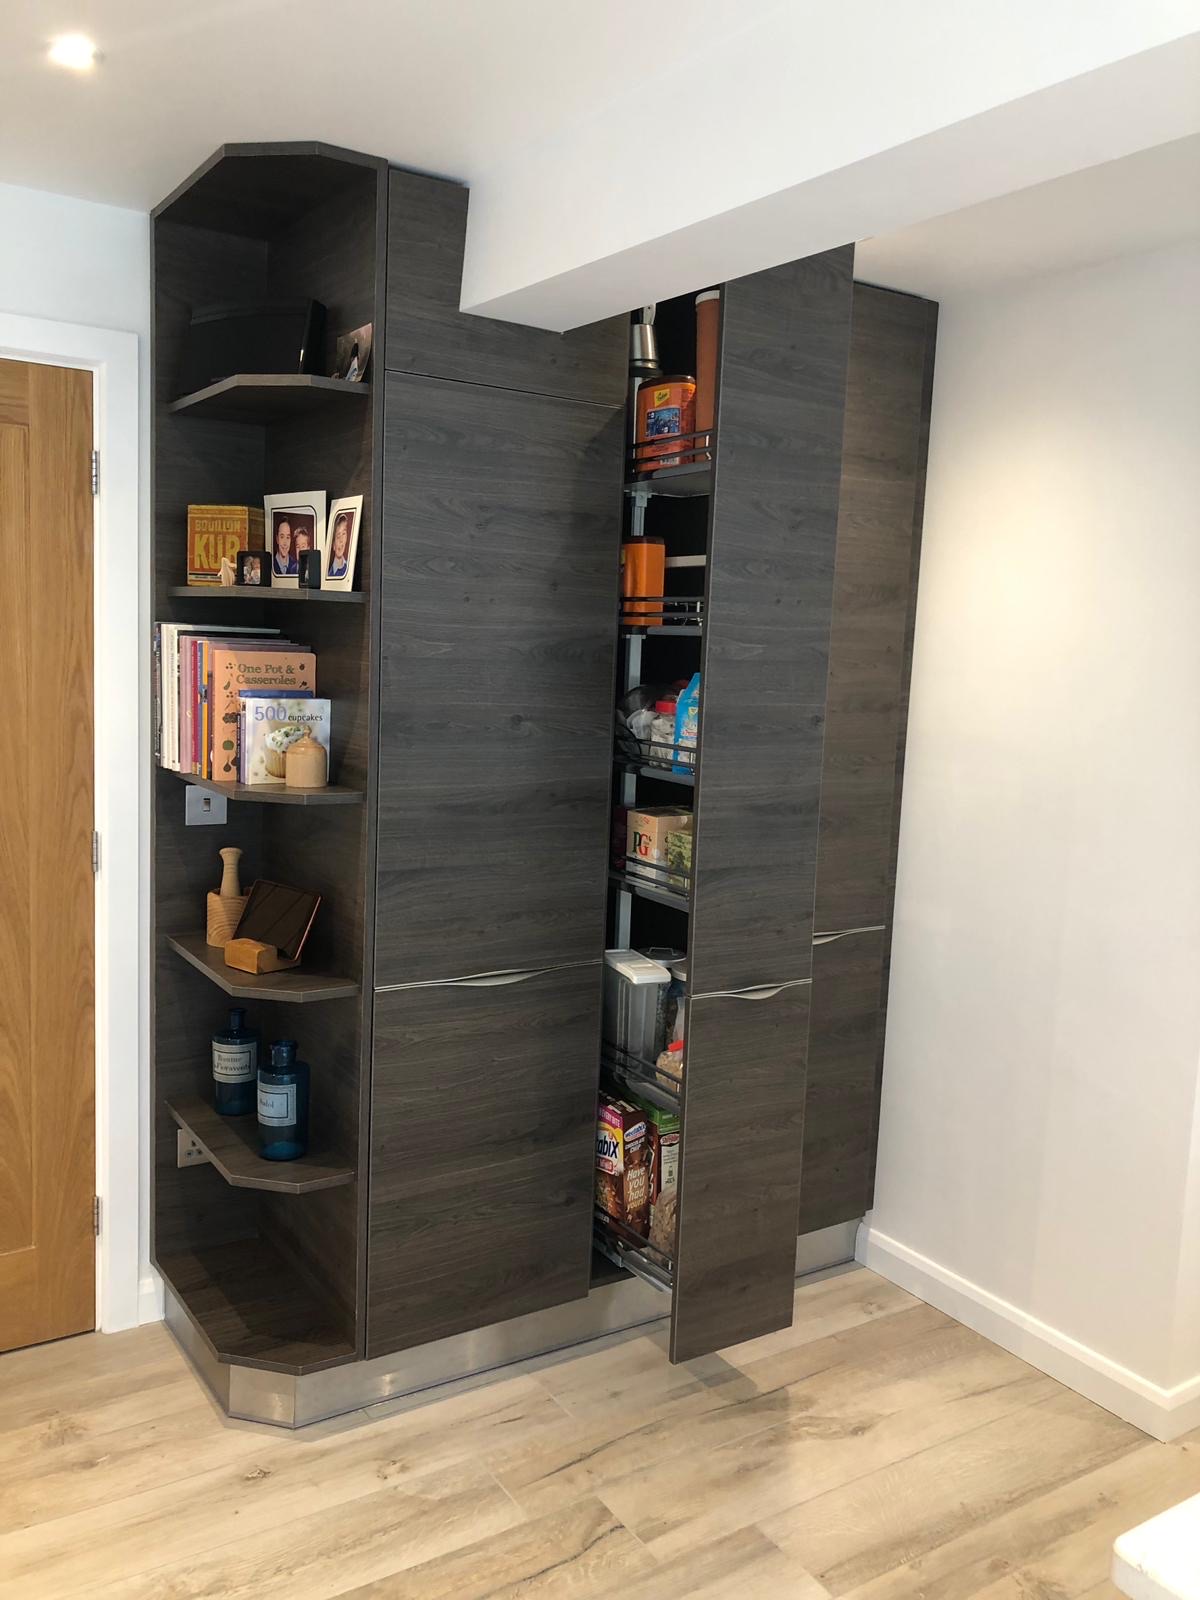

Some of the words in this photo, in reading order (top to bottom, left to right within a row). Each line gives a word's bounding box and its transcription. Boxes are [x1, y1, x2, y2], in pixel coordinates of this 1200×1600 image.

[195, 520, 241, 532] BOUILLON
[194, 534, 241, 569] KUB
[237, 663, 262, 674] One
[264, 664, 284, 674] Pot
[285, 665, 295, 674] &
[236, 674, 297, 686] Casseroles
[254, 705, 288, 722] 500
[288, 713, 323, 723] cupcakes
[633, 831, 649, 856] PG
[627, 1167, 646, 1181] Have
[630, 1176, 645, 1192] you
[628, 1186, 645, 1202] had
